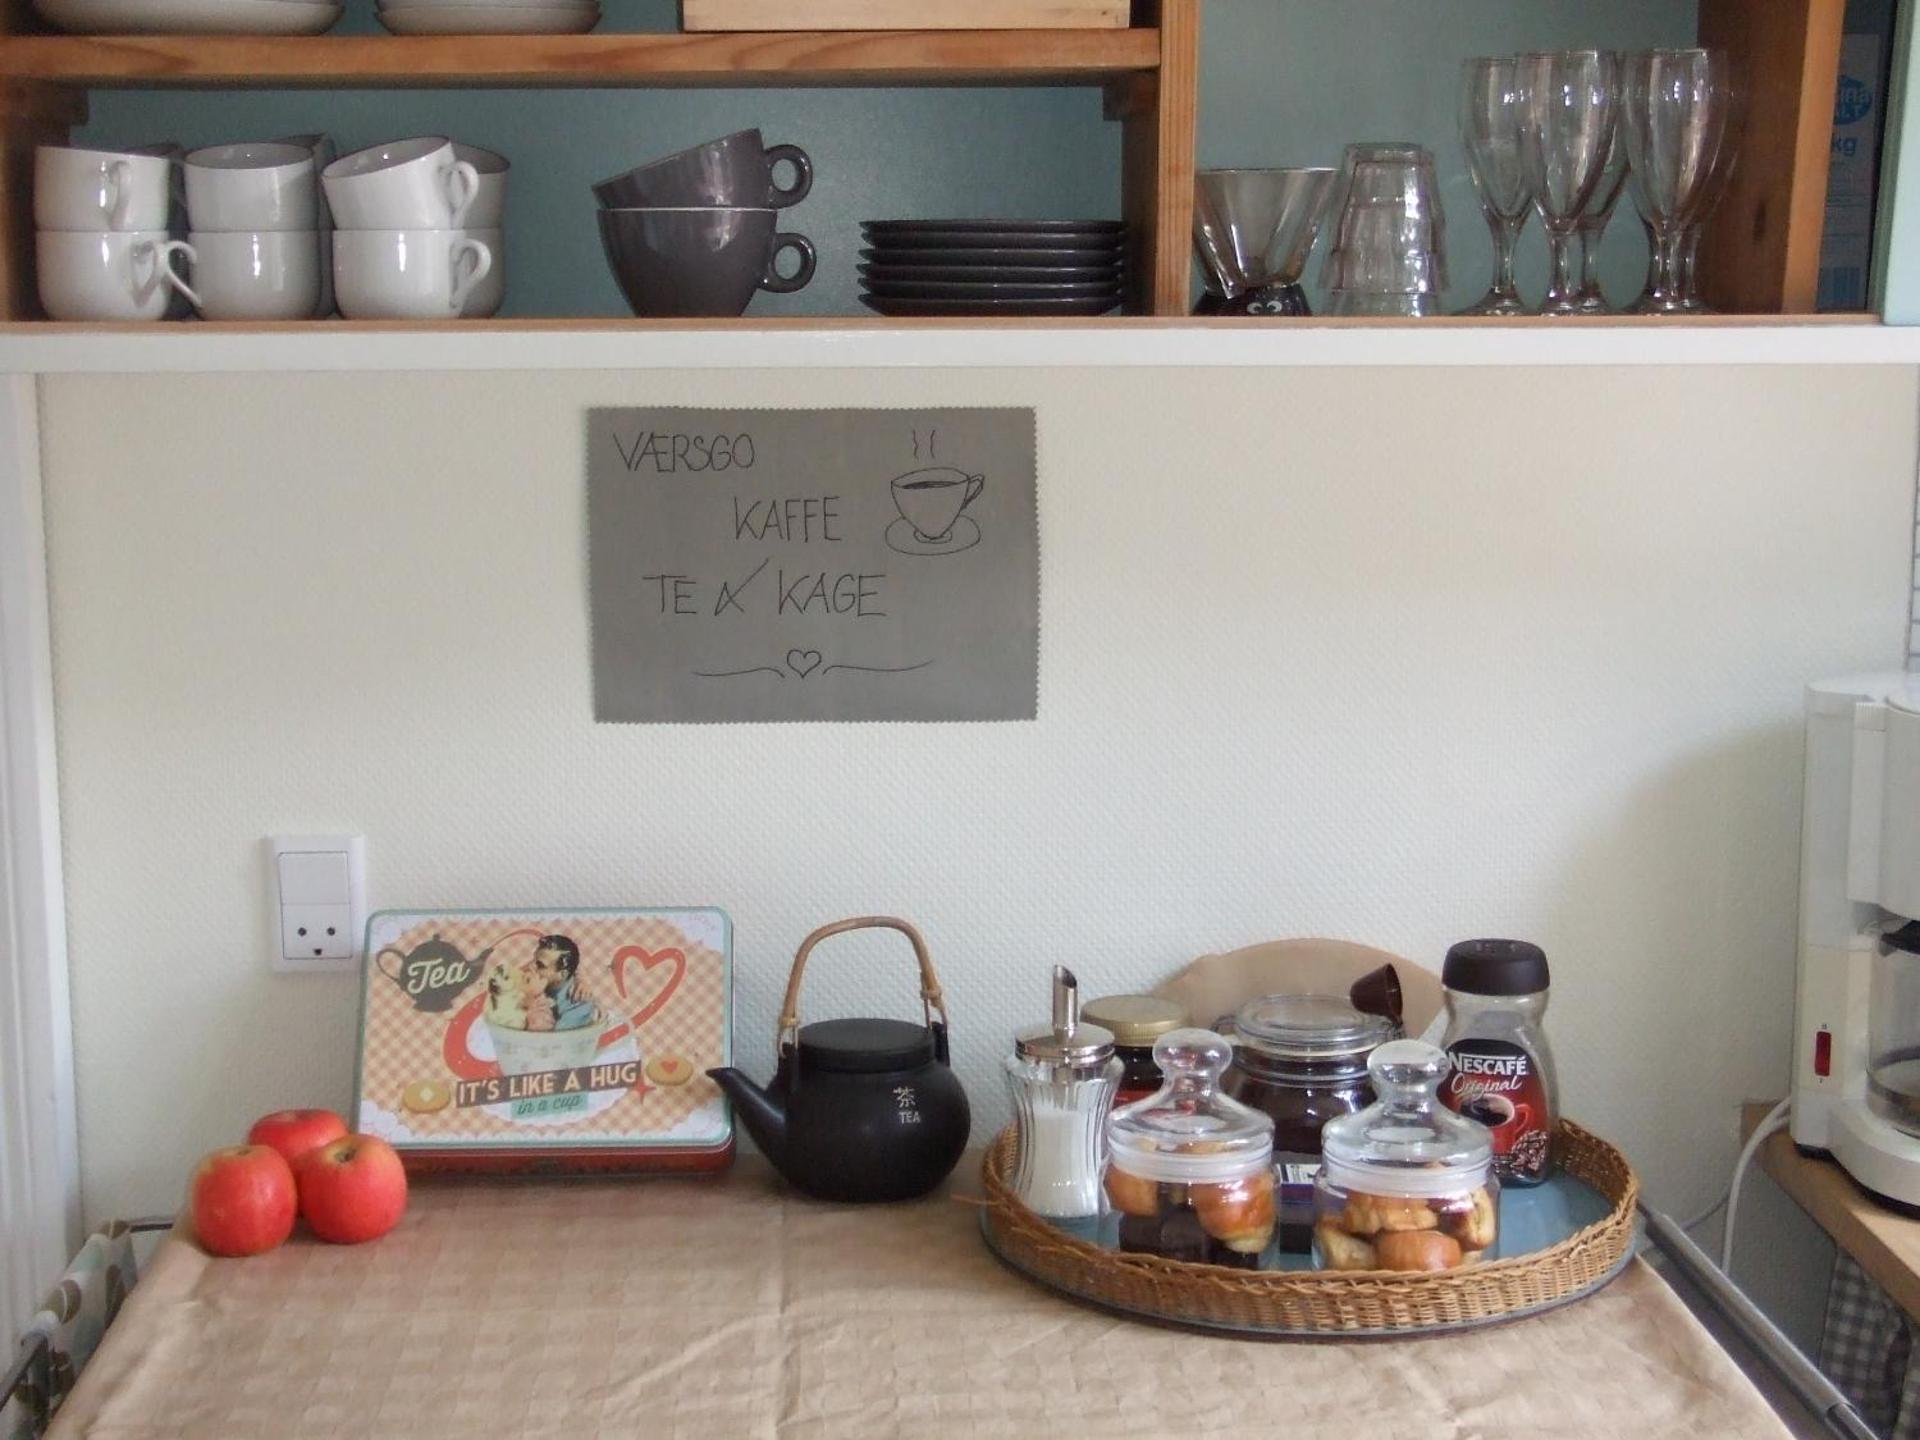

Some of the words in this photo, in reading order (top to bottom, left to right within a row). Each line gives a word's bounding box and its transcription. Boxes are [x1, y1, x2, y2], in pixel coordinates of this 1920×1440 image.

[612, 432, 756, 473] VÆRSGO
[733, 495, 842, 543] KAFFE
[642, 574, 698, 615] TE
[777, 569, 888, 617] KAGE
[407, 957, 471, 995] Tea
[1448, 1051, 1527, 1076] NESCAFÉ
[458, 1079, 500, 1105] IT'S
[509, 1072, 555, 1098] LIKE
[564, 1070, 581, 1092] A
[590, 1062, 637, 1089] HUG
[893, 1085, 916, 1108] 茶
[1450, 1072, 1523, 1101] Original
[517, 1100, 533, 1115] in
[537, 1100, 548, 1111] a
[552, 1094, 582, 1111] cup
[899, 1110, 921, 1124] TEA
